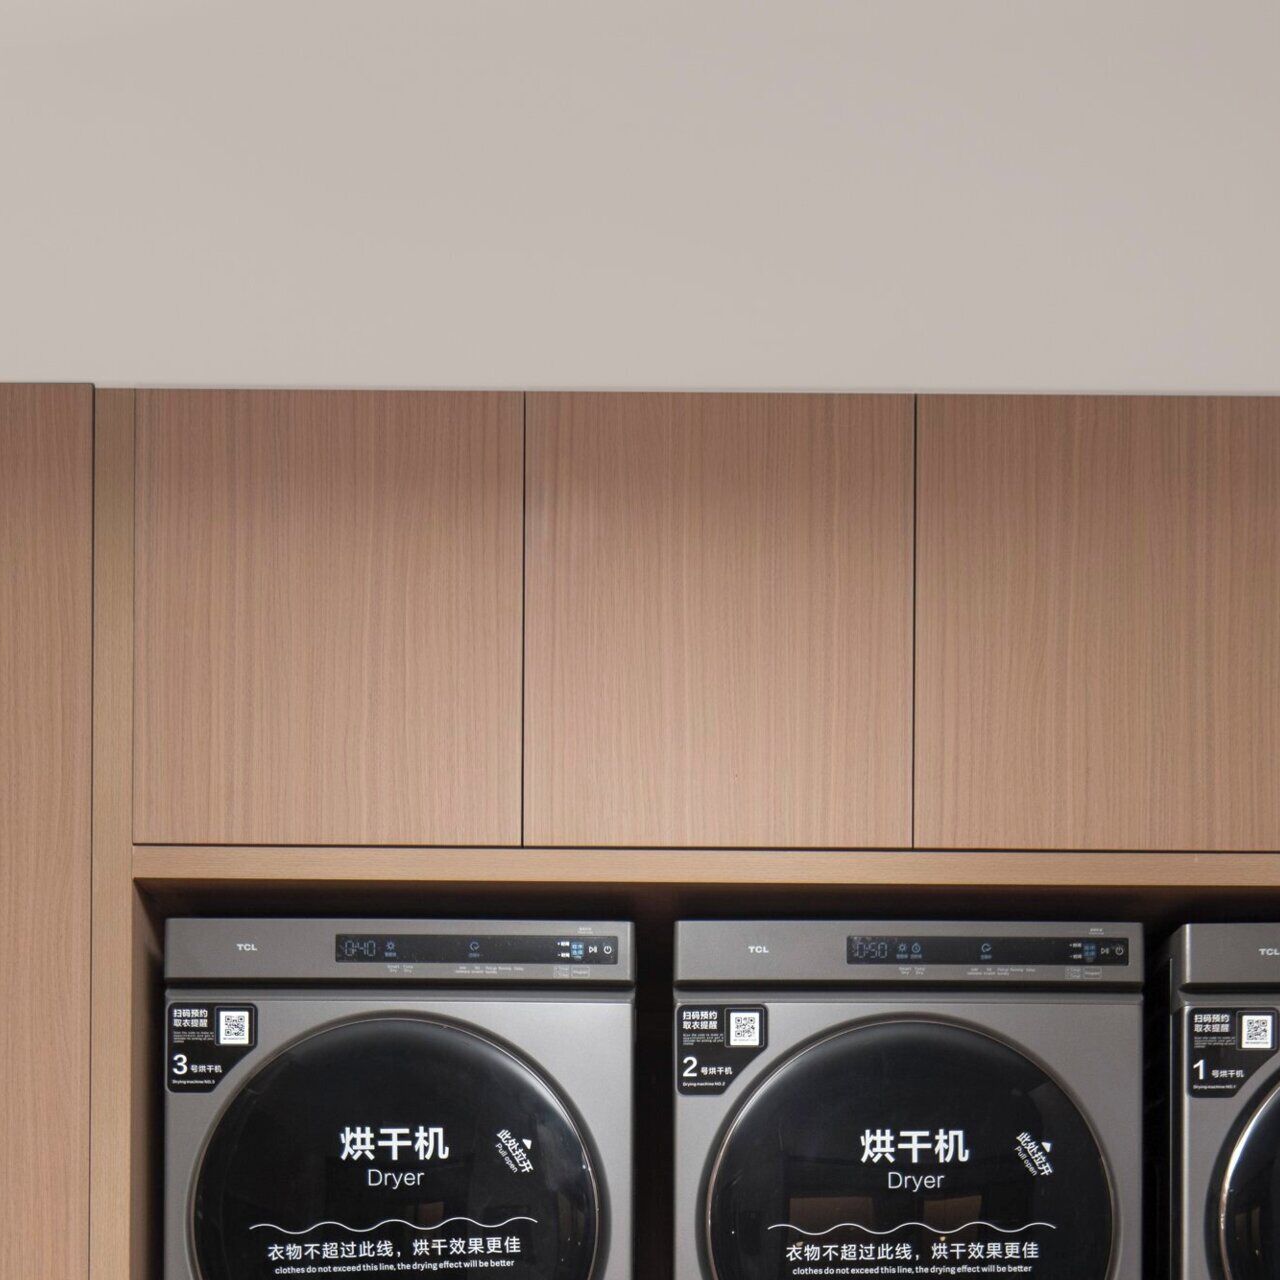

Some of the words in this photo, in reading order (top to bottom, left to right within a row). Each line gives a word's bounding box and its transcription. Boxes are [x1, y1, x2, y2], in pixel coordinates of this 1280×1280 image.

[173, 1009, 208, 1019] 扫码预约
[173, 1019, 207, 1027] 取衣提醒
[683, 1011, 717, 1021] 扫码预约
[1194, 1014, 1230, 1024] 扫码预约
[683, 1020, 717, 1029] 取衣提醒
[1194, 1023, 1229, 1032] 取衣提醒
[173, 1054, 187, 1074] 3
[191, 1065, 222, 1073] 号烘干机
[683, 1057, 697, 1077] 2
[701, 1067, 732, 1075] 号烘干机
[1193, 1060, 1204, 1079] 1
[1212, 1070, 1244, 1078] 号烘干机
[340, 1126, 449, 1160] 烘干机
[497, 1129, 534, 1172] 此处拉开
[860, 1129, 969, 1163] 烘干机
[496, 1143, 508, 1156] Pull
[505, 1156, 518, 1173] open
[1015, 1146, 1026, 1160] Pull
[1024, 1160, 1038, 1176] open
[1016, 1132, 1053, 1176] 此处拉开
[368, 1169, 424, 1189] Dryer
[888, 1172, 944, 1192] Dryer
[268, 1236, 521, 1261] 衣物不超过此线，烘干效果更佳
[786, 1240, 1039, 1261] 衣物不超过此线，烘干效果更佳
[274, 1266, 304, 1274] clothes
[306, 1265, 316, 1273] do
[332, 1264, 361, 1272] exceed
[362, 1263, 378, 1271] this
[379, 1262, 395, 1271] line,
[412, 1261, 437, 1271] drying
[438, 1260, 462, 1268] effect
[463, 1259, 477, 1267] will
[478, 1259, 488, 1267] be
[490, 1258, 514, 1266] better
[792, 1266, 822, 1274] clothes
[824, 1266, 834, 1274] do
[850, 1266, 879, 1274] exceed
[897, 1265, 914, 1273] line,
[915, 1265, 928, 1273] the
[930, 1265, 955, 1274] drying
[956, 1264, 980, 1272] effect
[981, 1264, 995, 1272] will
[1007, 1264, 1031, 1272] better
